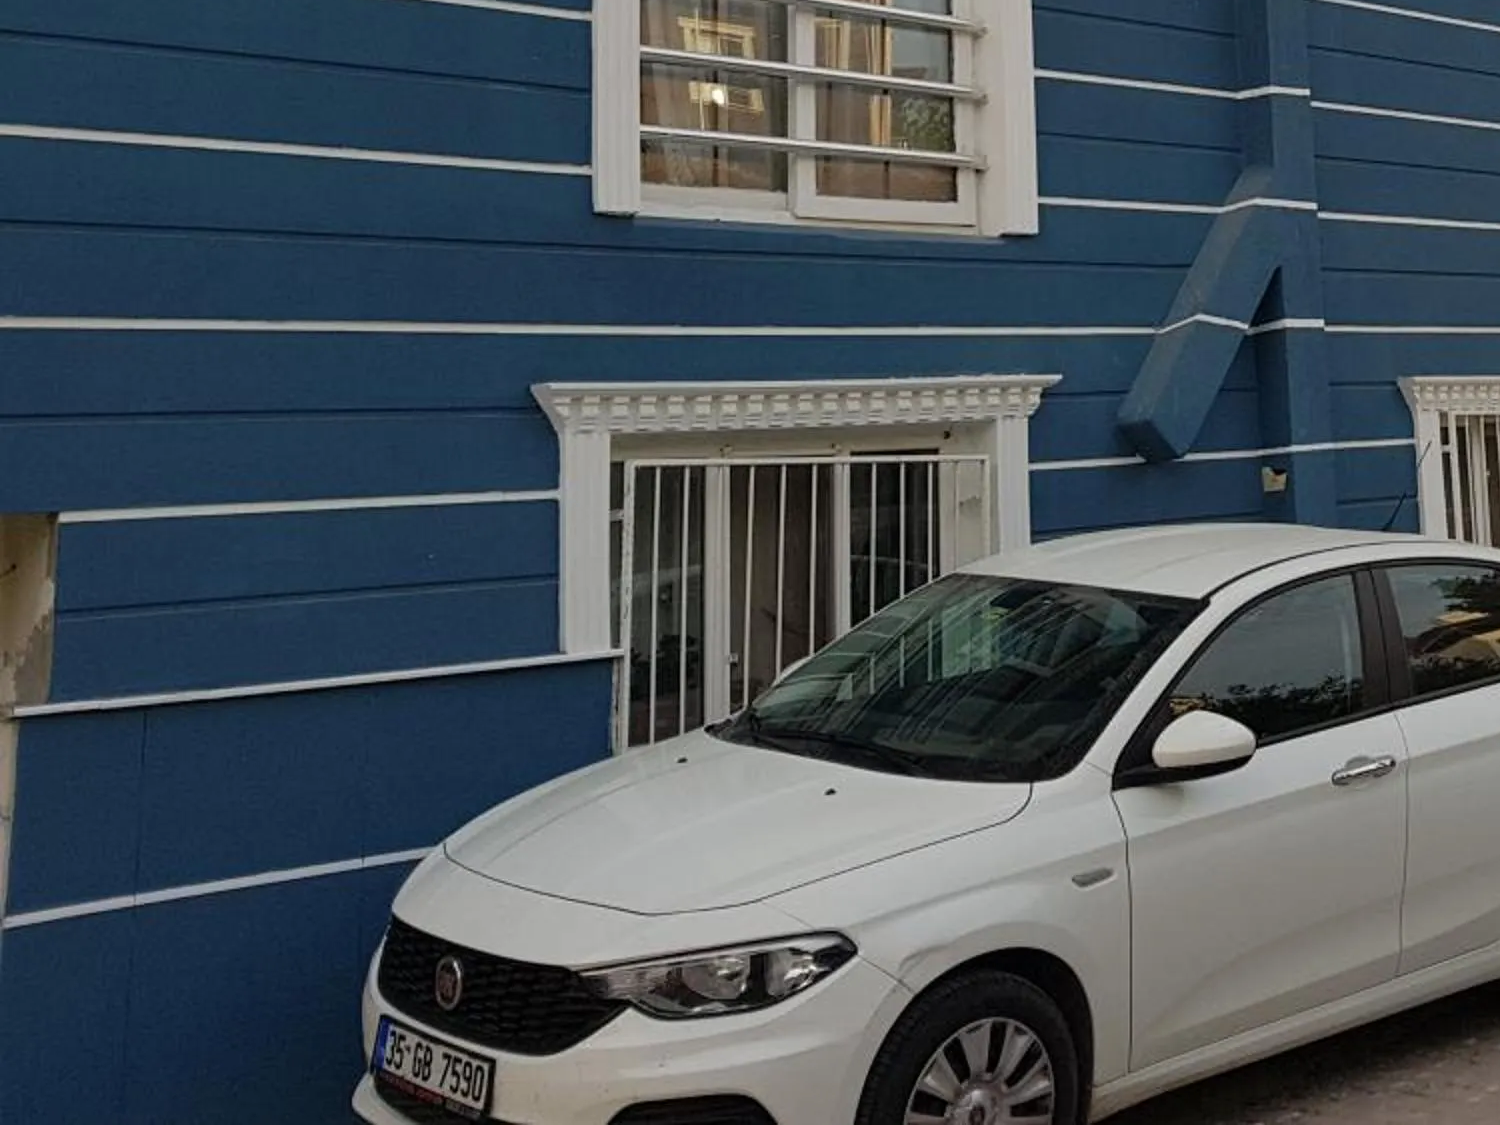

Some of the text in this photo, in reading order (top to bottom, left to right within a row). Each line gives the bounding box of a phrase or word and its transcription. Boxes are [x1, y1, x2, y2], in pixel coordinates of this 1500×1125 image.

[385, 1030, 406, 1070] 35
[412, 1041, 433, 1082] GB
[439, 1052, 485, 1102] 7590
